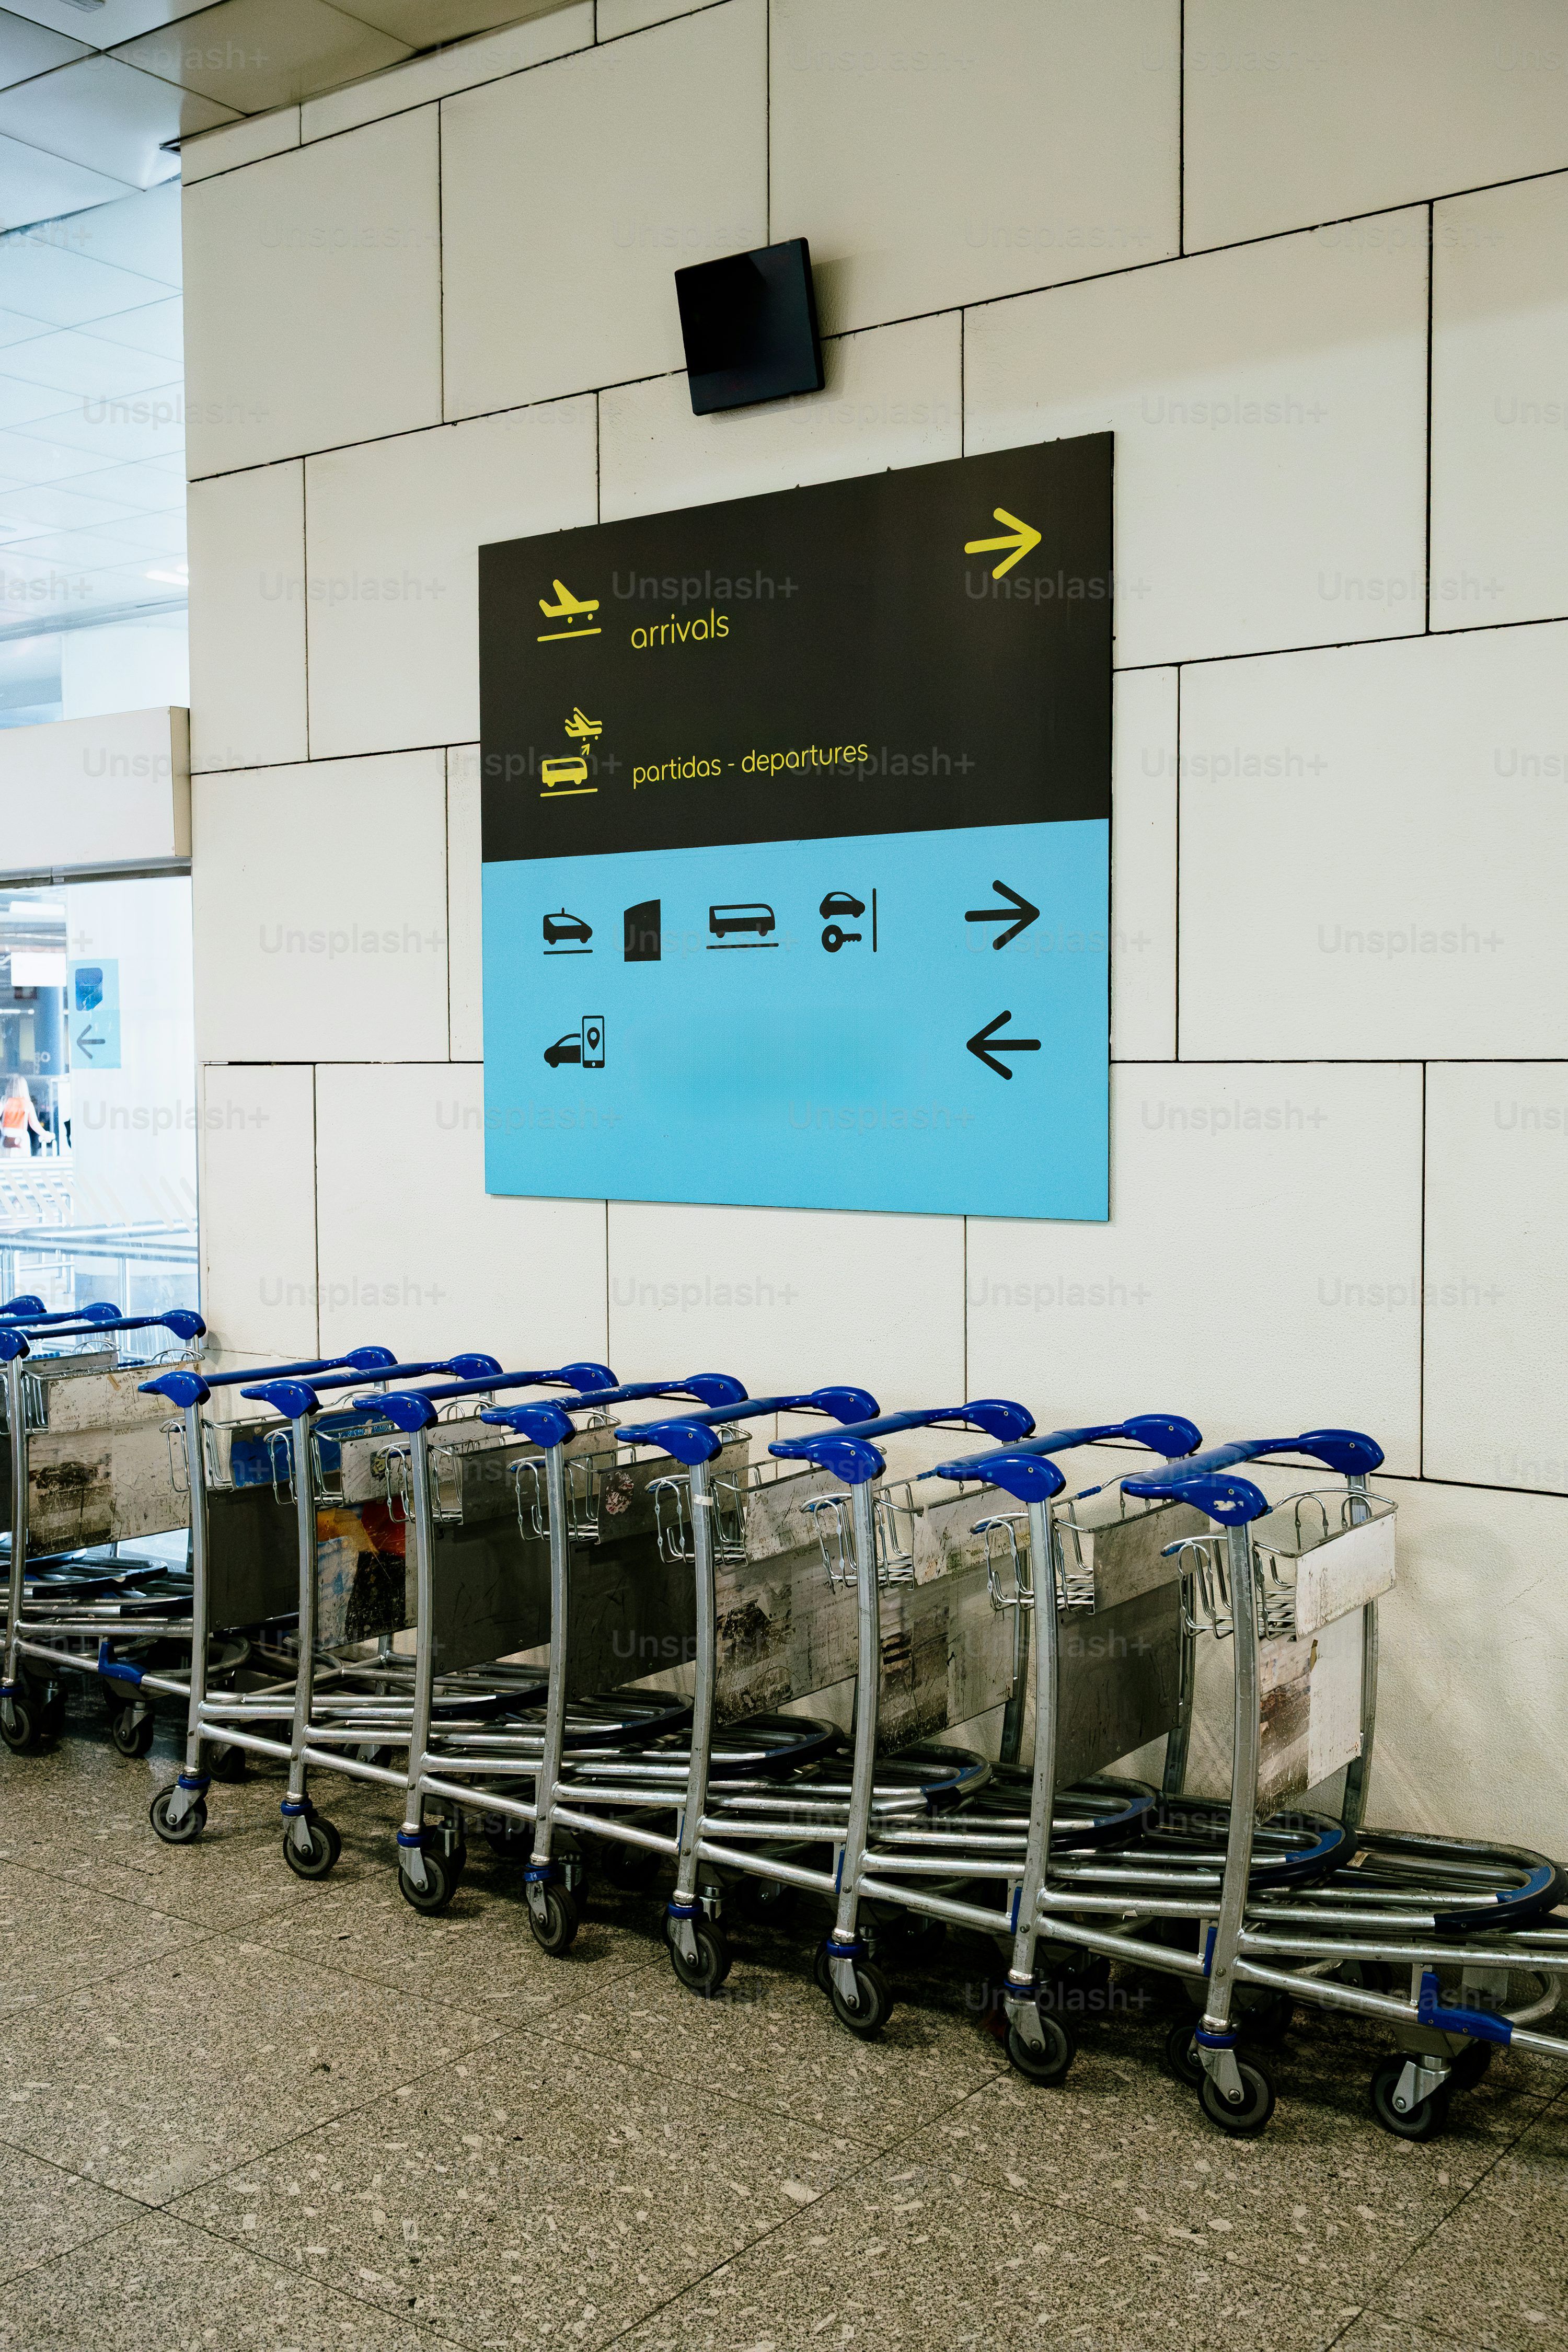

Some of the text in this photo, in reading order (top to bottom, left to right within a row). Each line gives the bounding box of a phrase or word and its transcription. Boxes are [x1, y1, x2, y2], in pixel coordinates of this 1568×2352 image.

[631, 607, 730, 649] arrivals
[633, 755, 721, 790] partidas
[741, 743, 869, 777] departures
